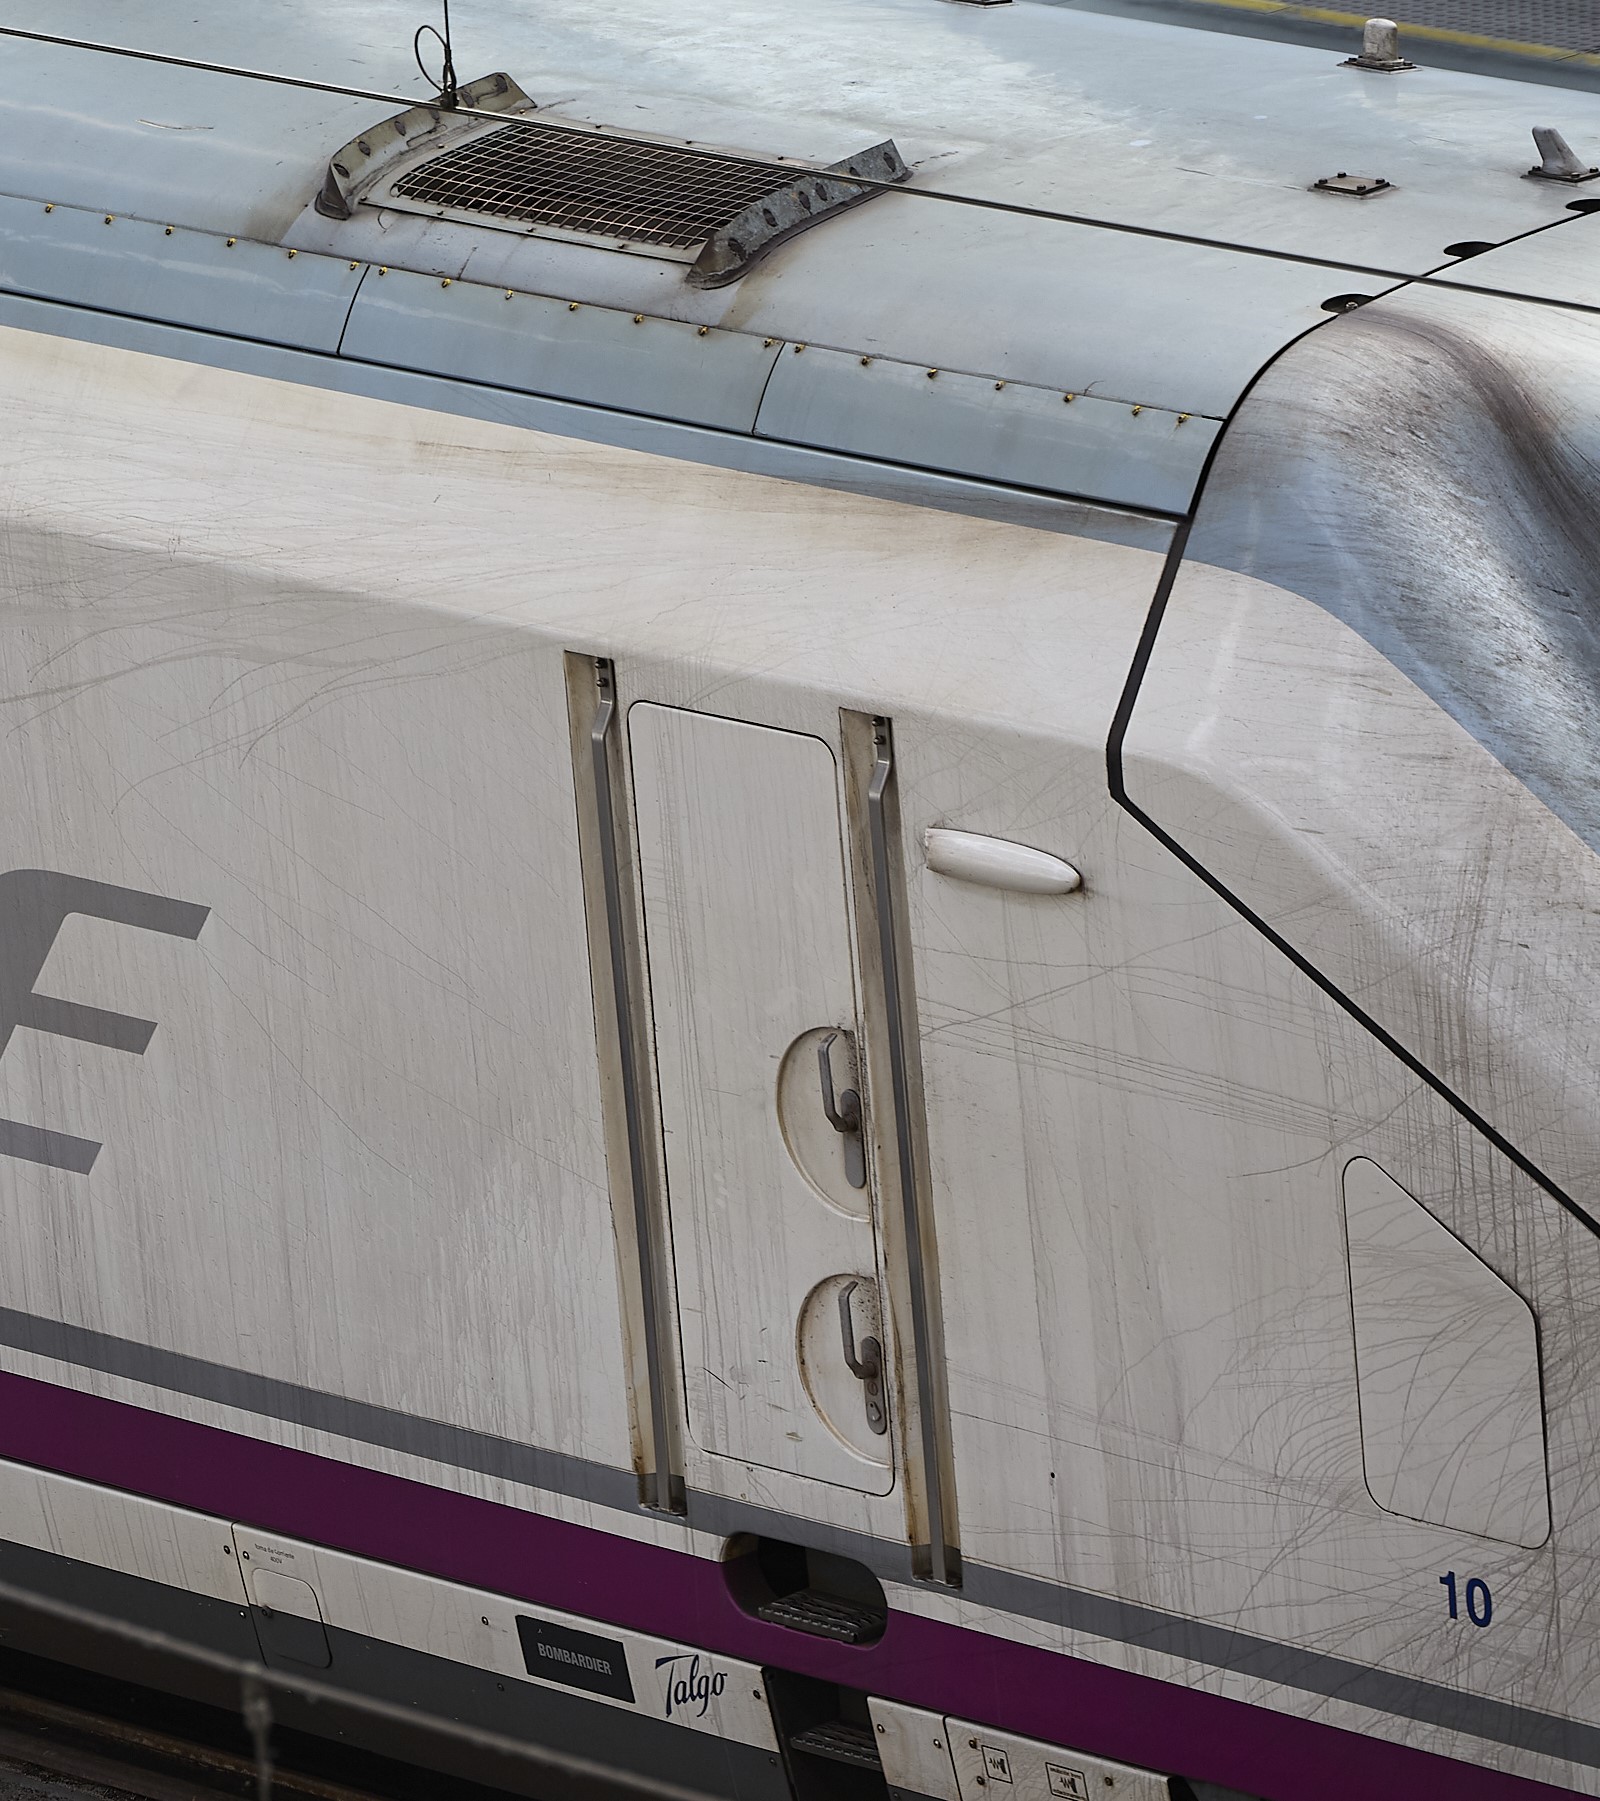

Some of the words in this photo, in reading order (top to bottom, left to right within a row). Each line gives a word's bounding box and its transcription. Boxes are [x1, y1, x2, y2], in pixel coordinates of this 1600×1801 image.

[1439, 1570, 1493, 1628] 10
[537, 1642, 613, 1676] BOMBARDIER
[655, 1654, 728, 1719] Talgo
